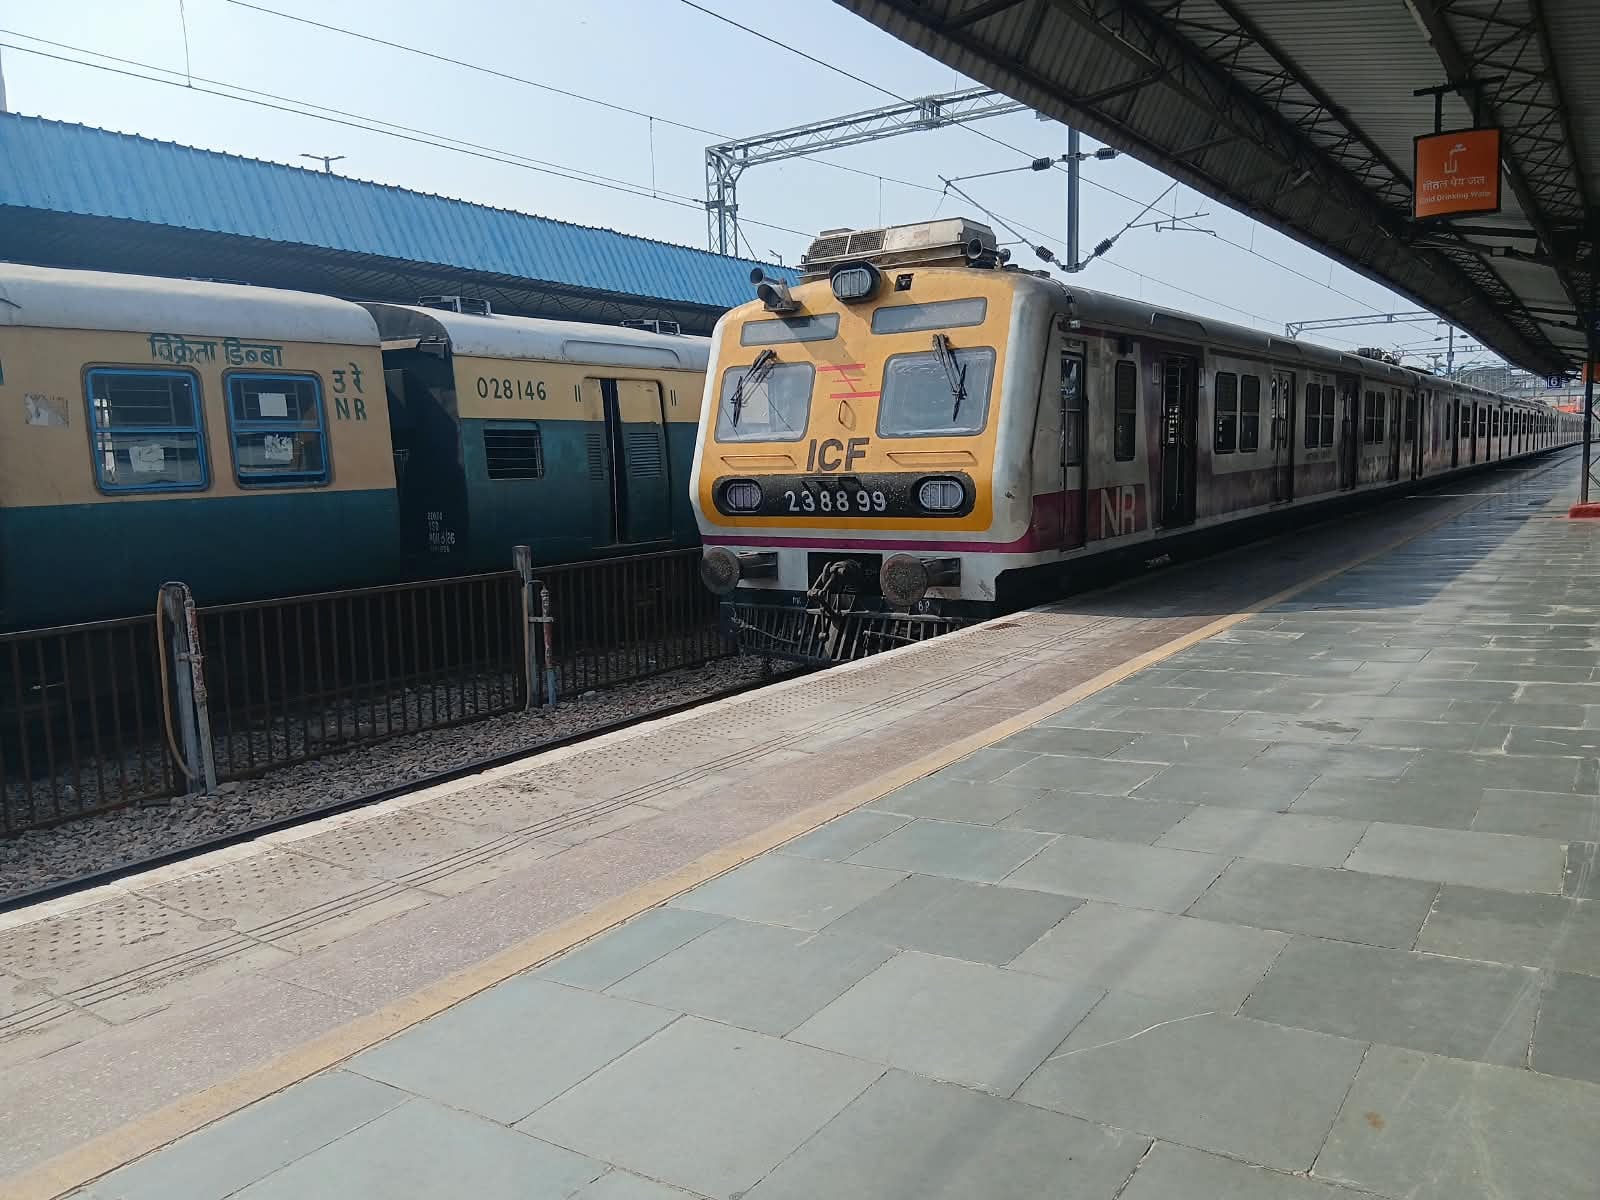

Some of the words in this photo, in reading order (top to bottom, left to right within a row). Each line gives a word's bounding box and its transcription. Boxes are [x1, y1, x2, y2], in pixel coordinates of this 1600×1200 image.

[148, 333, 217, 364] विक्रेता
[222, 336, 284, 367] डिब्बा
[476, 376, 547, 401] 028146
[334, 397, 368, 421] NR
[805, 437, 870, 472] ICF
[1099, 485, 1137, 540] NR
